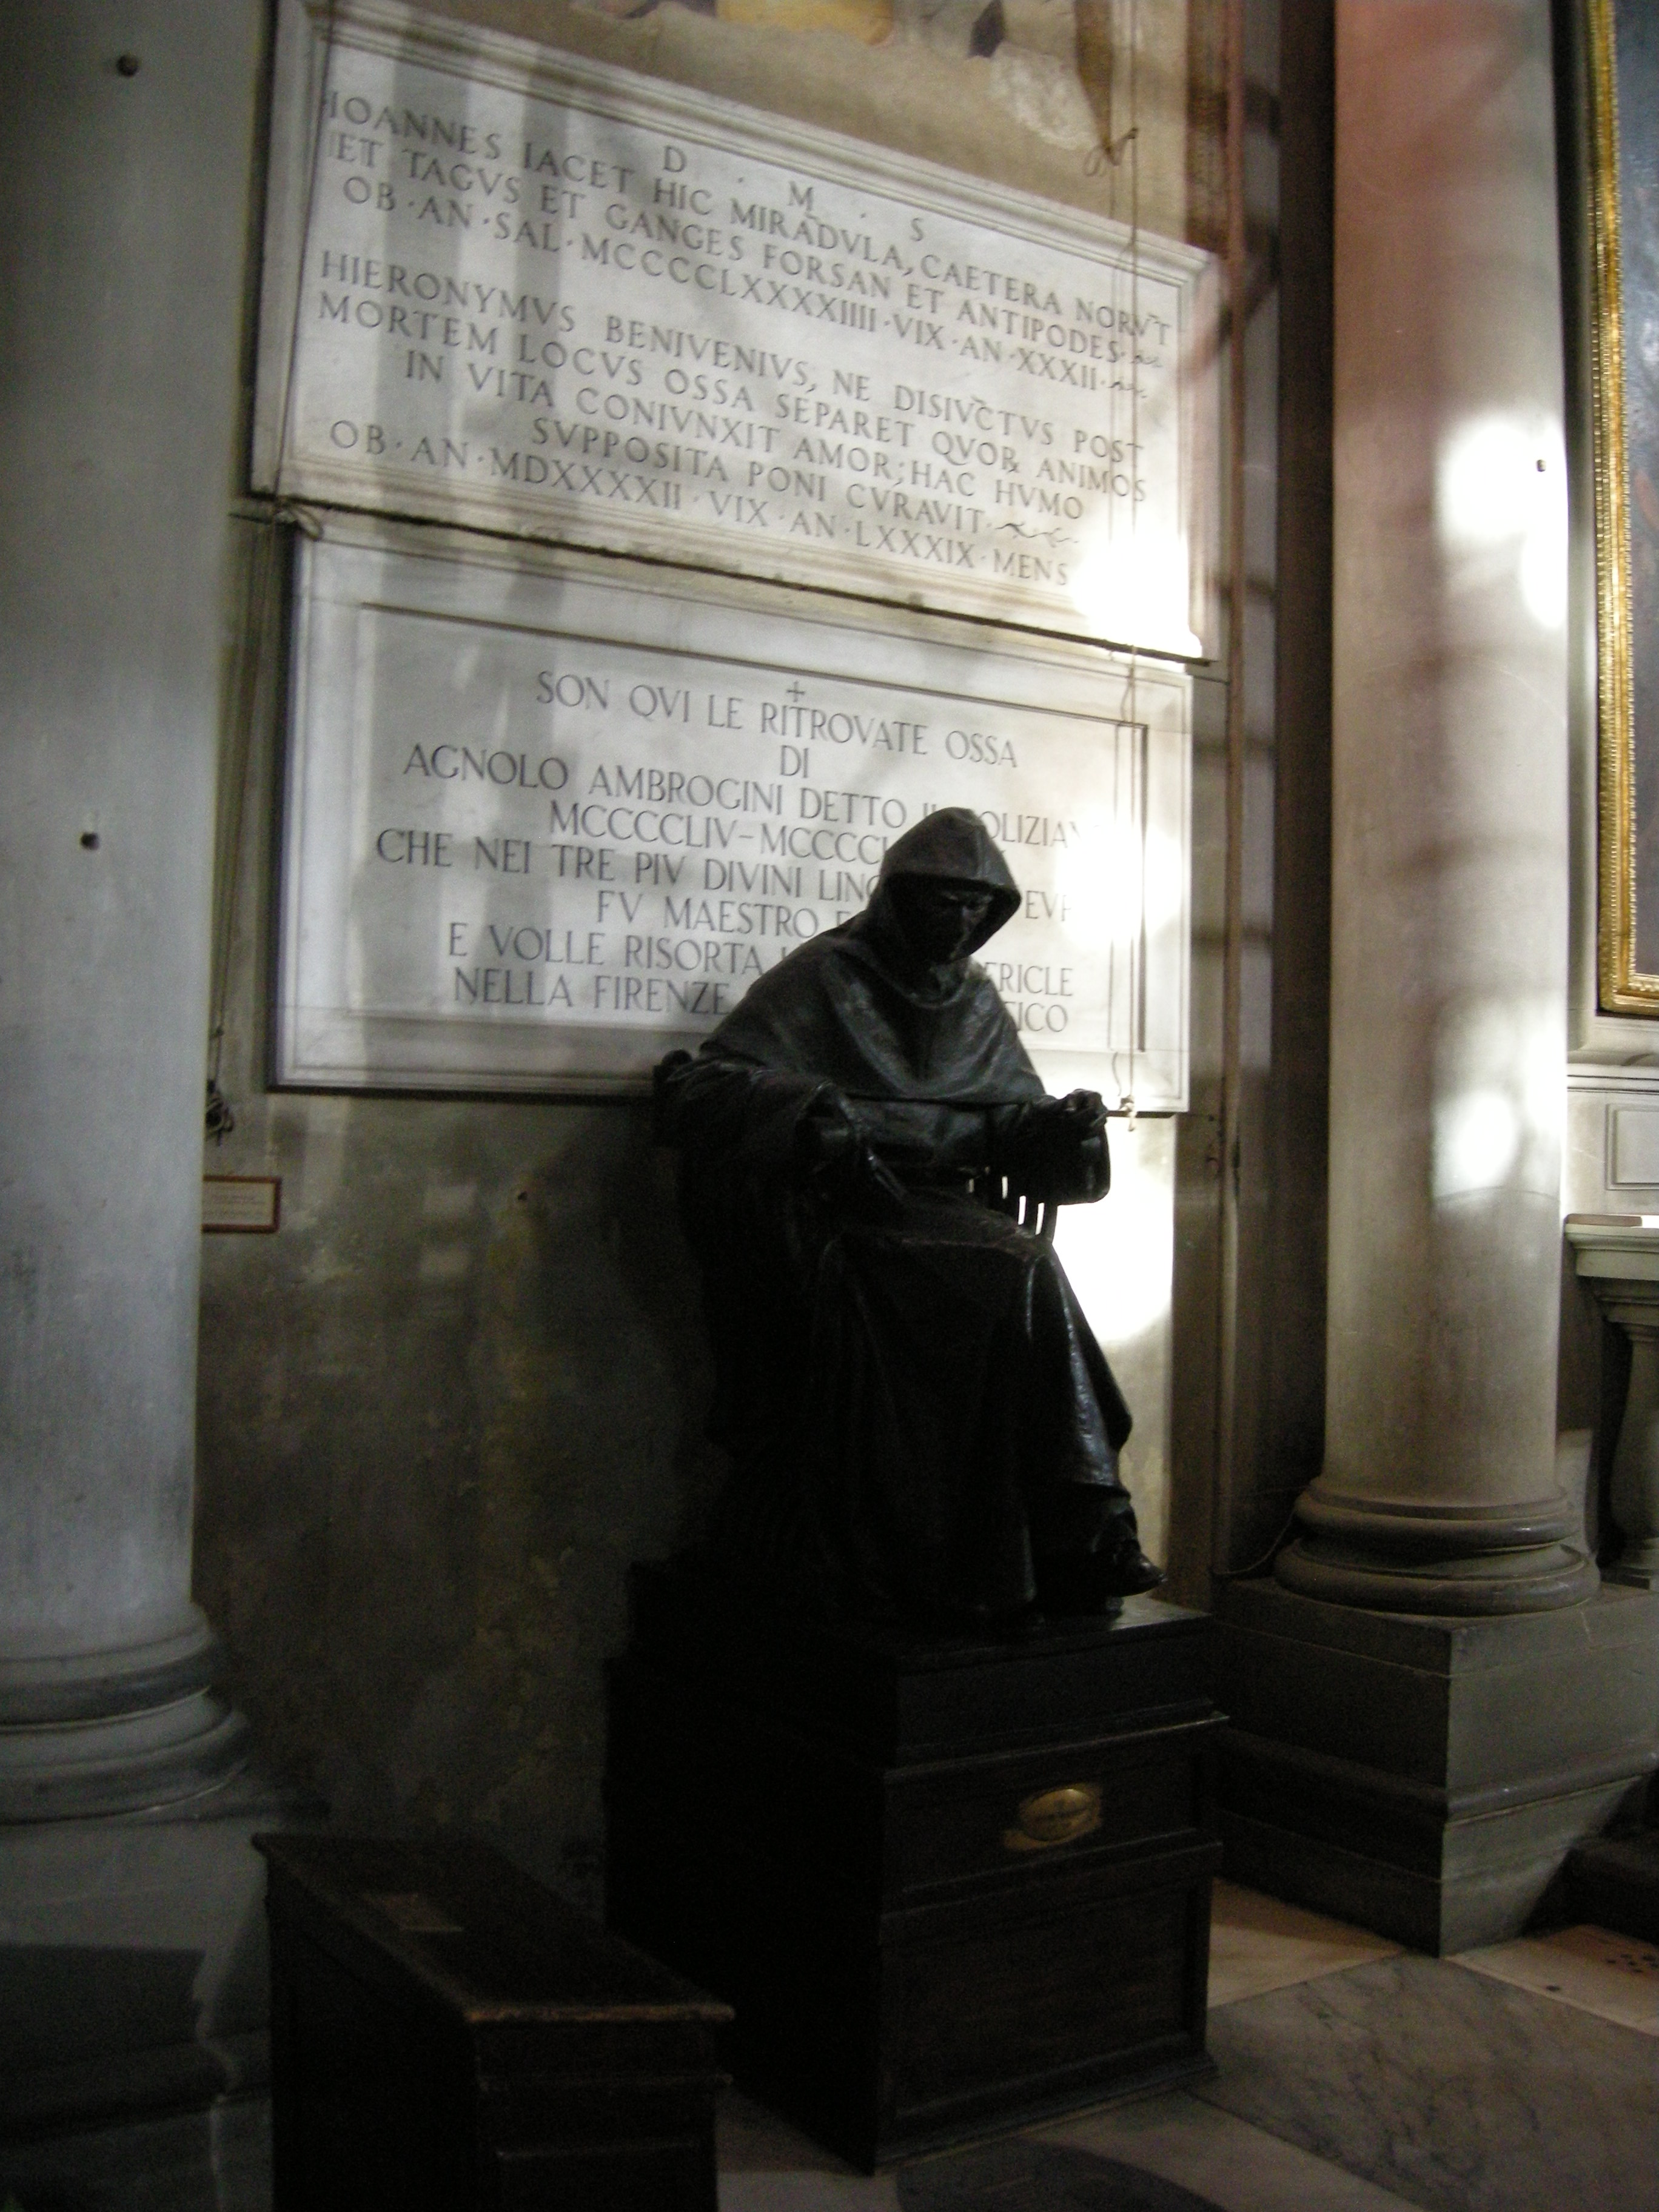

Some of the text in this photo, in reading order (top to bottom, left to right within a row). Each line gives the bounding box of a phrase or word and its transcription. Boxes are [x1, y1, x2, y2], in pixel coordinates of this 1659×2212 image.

[330, 92, 502, 159] IOANNES
[524, 142, 635, 193] IACET
[653, 178, 712, 215] HIC
[920, 253, 1062, 315] CAETERA
[336, 132, 384, 167] ET
[402, 148, 520, 203] TAGVS
[541, 184, 586, 219] ET
[605, 203, 745, 261] GANGES
[762, 244, 891, 298] FORSAN
[907, 283, 944, 313] ET
[663, 144, 925, 241] D M S
[318, 290, 498, 355] MORTEM
[519, 333, 643, 386] LOCVS
[665, 368, 754, 412] OSSA
[775, 393, 915, 447] SEPARET
[1036, 457, 1147, 502] ANIMOS
[321, 250, 575, 332] HIERONYMVS
[833, 369, 871, 401] NE
[1073, 429, 1144, 468] POST
[404, 349, 444, 381] IN
[468, 363, 554, 407] VITA
[575, 387, 781, 452] CONIVNXIT
[911, 460, 975, 497] HAC
[995, 478, 1084, 520] HVMO
[531, 417, 728, 481] SVPPOSITA
[748, 460, 826, 502] PONI
[993, 548, 1068, 586] MENS
[536, 670, 1018, 768] SON QVI LE RITROVATE OSSA
[780, 744, 809, 779] DI
[403, 742, 569, 790] AGNOLO
[588, 763, 783, 816] AMBROGINI
[799, 787, 908, 828] DETTO
[376, 828, 453, 867] CHE
[474, 836, 531, 874] NEI
[551, 843, 615, 882] TRE
[635, 851, 686, 886] PIV
[704, 857, 802, 898] DIVINI
[449, 921, 468, 957] E
[488, 924, 606, 965] VOLLE
[625, 934, 765, 976] RISORTA
[597, 889, 644, 923] FV
[664, 895, 819, 939] MAESTRO
[454, 967, 574, 1008] NELLA
[594, 974, 730, 1016] FIRENZE
